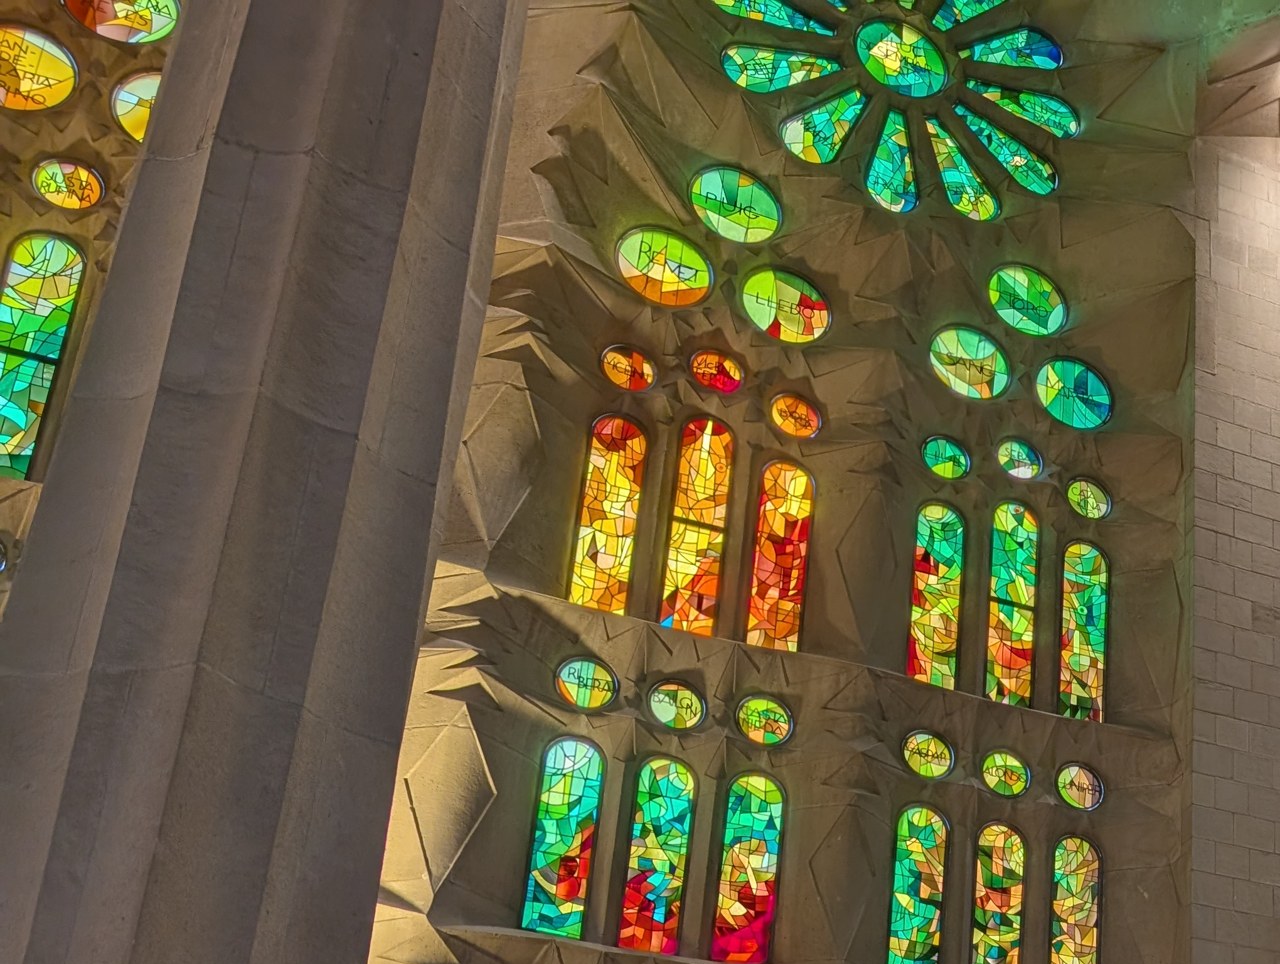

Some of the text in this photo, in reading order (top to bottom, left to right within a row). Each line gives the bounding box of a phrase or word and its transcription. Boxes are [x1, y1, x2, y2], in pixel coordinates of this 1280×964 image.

[0, 39, 36, 55] AN-
[45, 171, 95, 194] JUSTA
[704, 191, 760, 220] PUIG
[755, 292, 815, 320] LLEDO
[1007, 292, 1049, 318] TORO
[946, 351, 994, 378] SANG
[567, 666, 615, 695] RIBERA
[983, 764, 1027, 784] ALONSO
